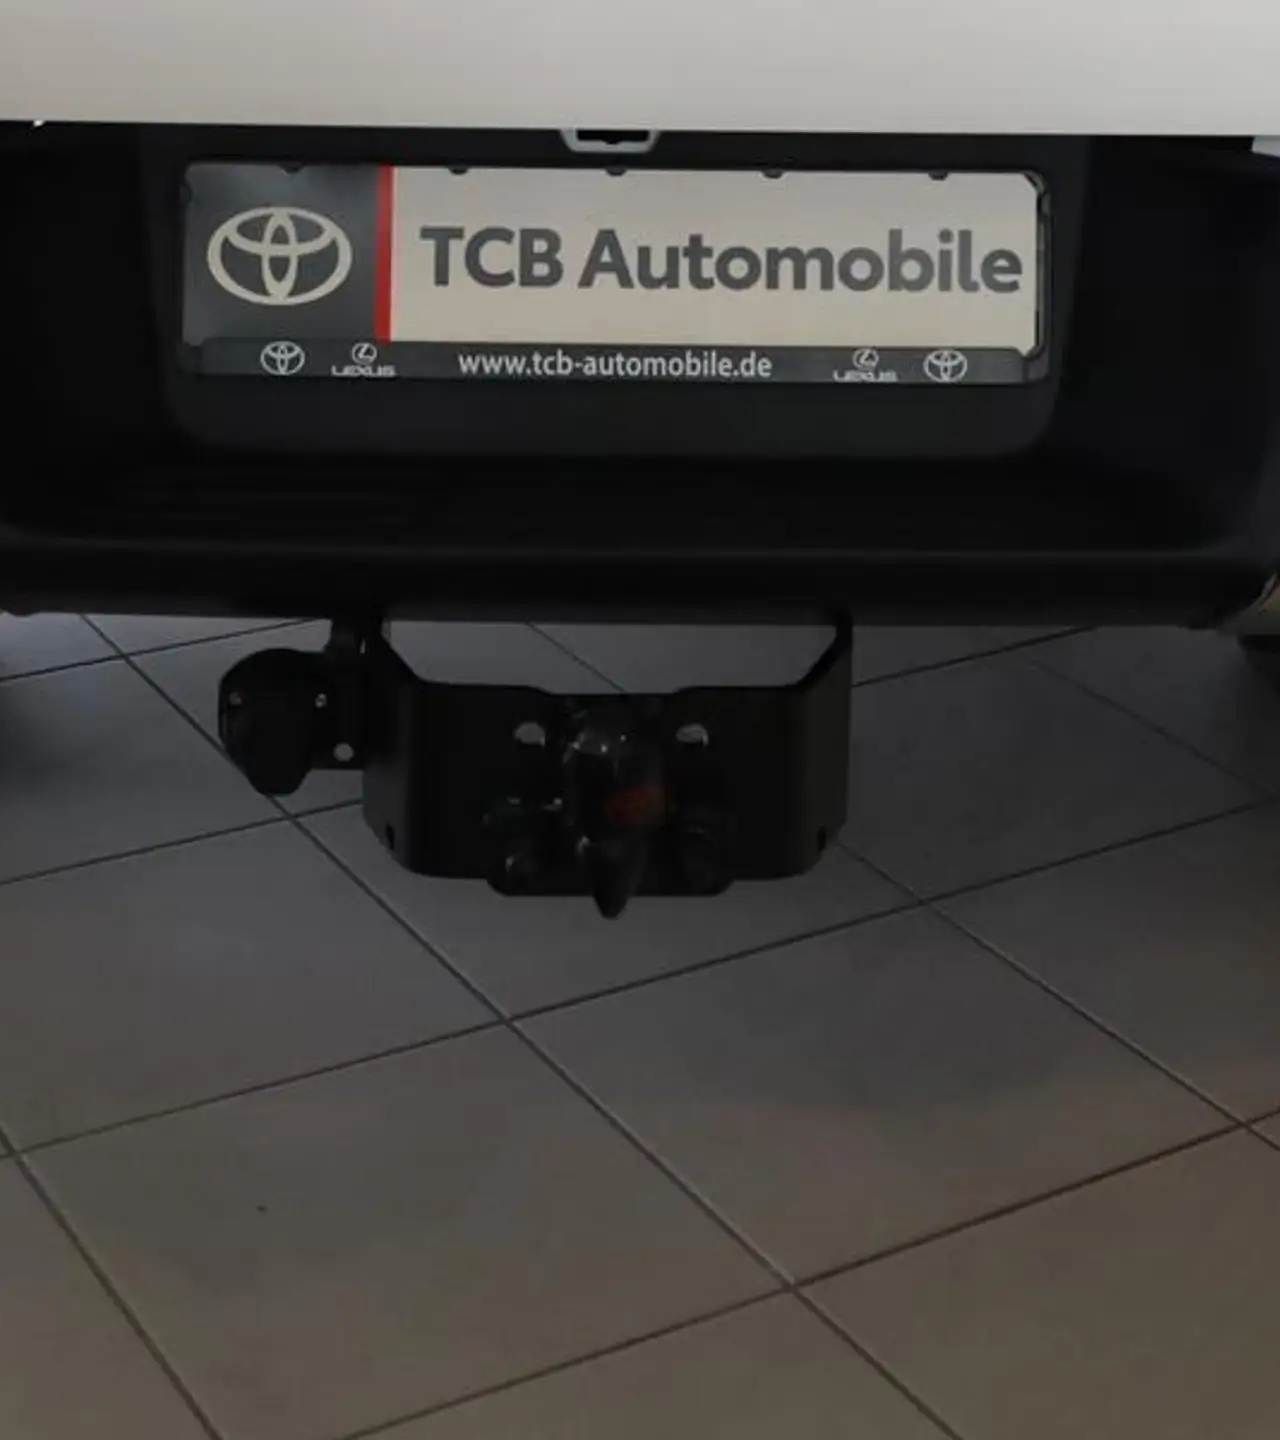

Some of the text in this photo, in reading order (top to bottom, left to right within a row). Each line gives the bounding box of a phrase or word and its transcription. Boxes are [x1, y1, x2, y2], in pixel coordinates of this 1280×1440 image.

[420, 227, 1023, 293] TCB Automobile
[458, 348, 773, 379] www.tcb-automobile.de
